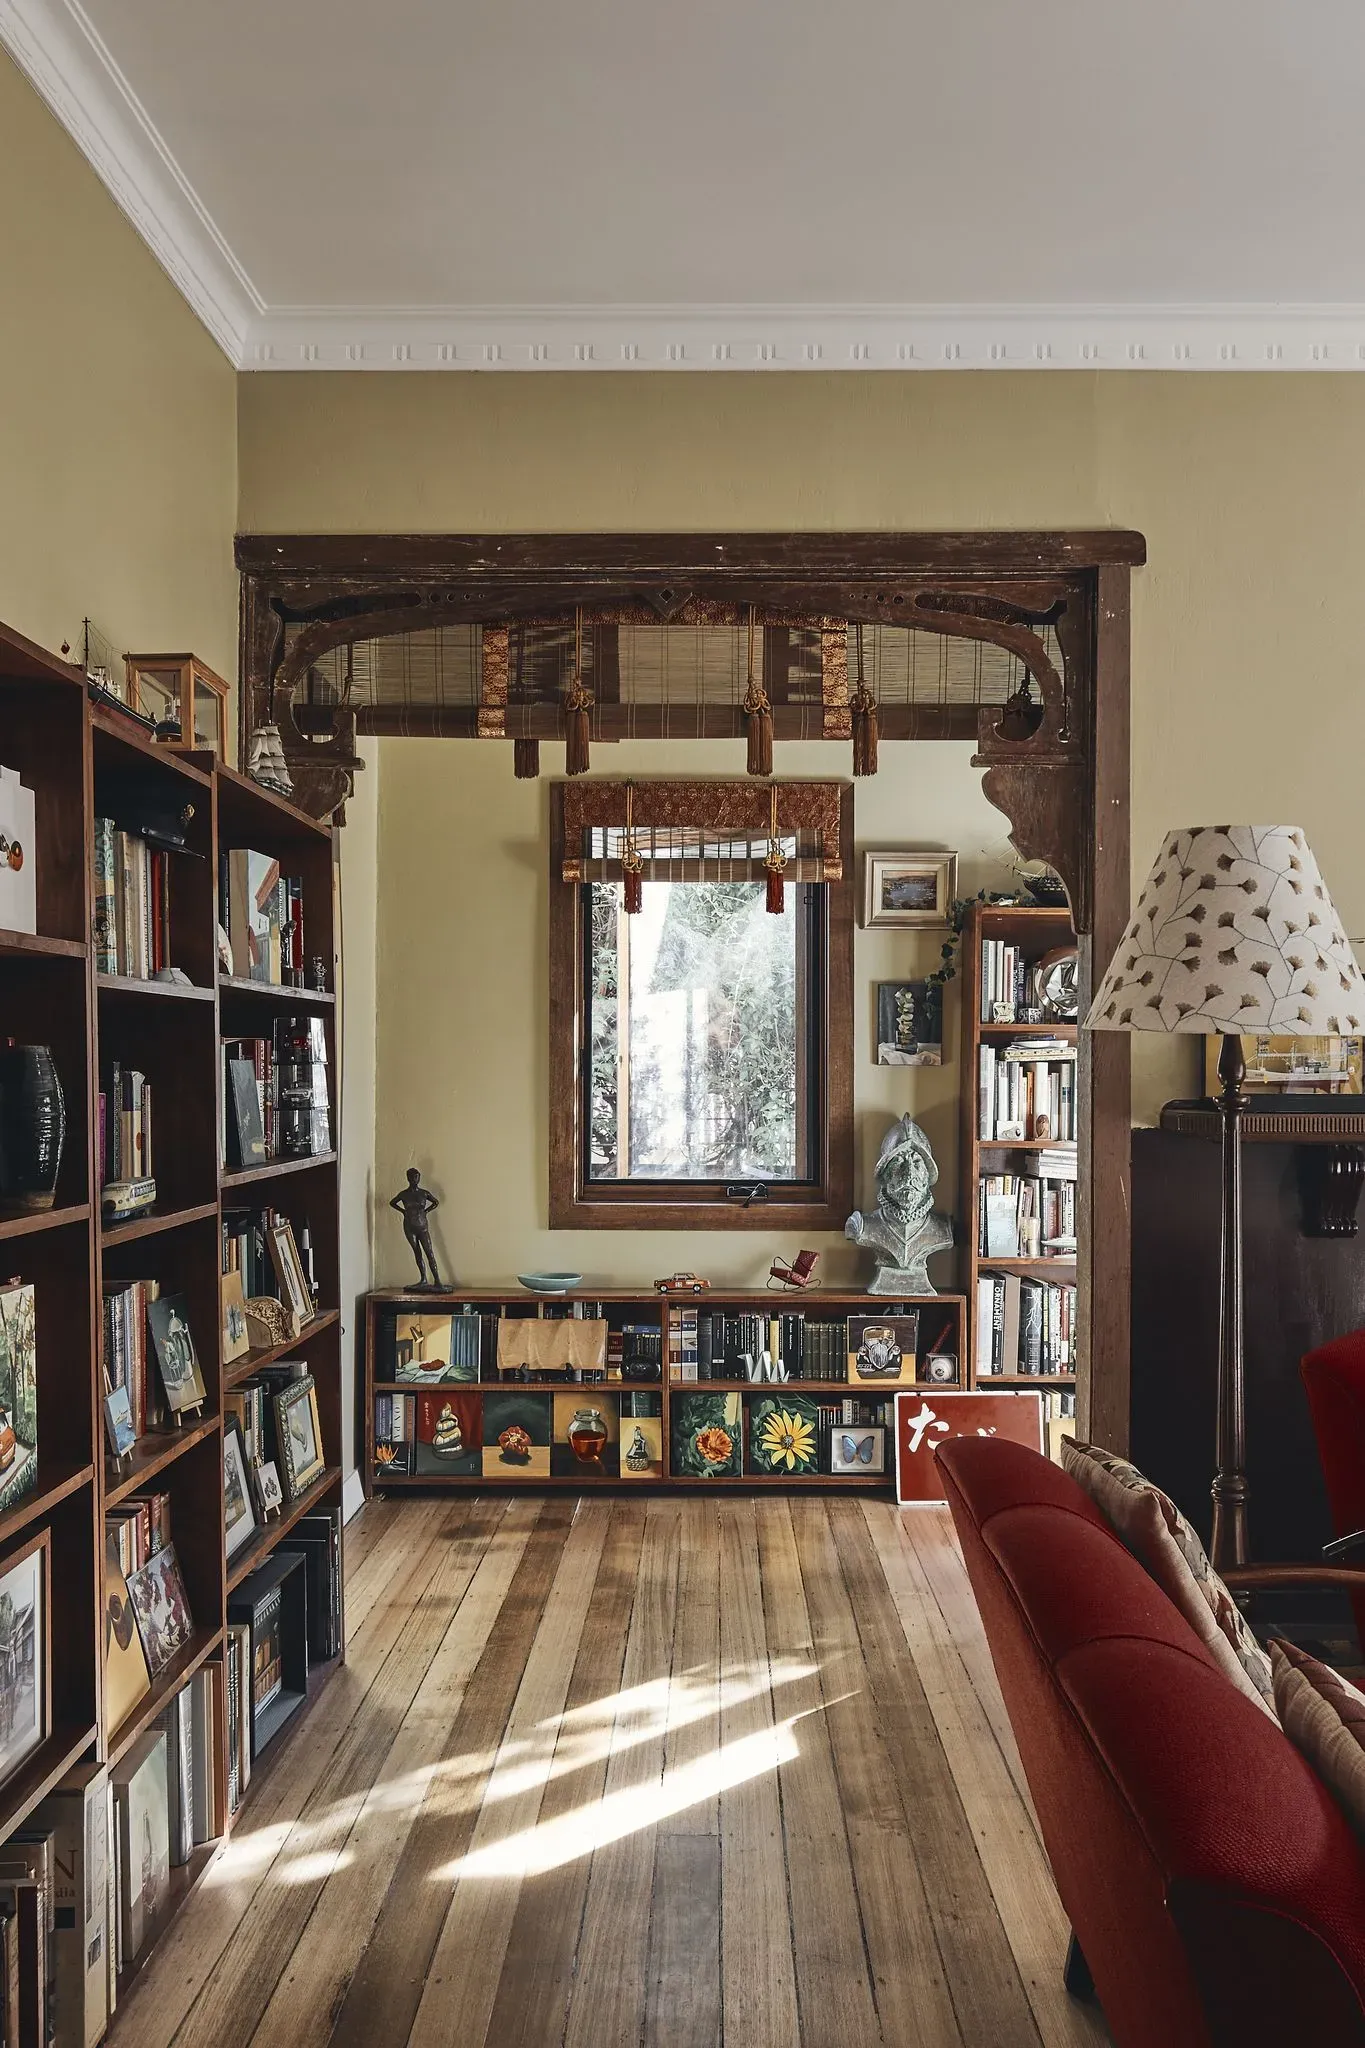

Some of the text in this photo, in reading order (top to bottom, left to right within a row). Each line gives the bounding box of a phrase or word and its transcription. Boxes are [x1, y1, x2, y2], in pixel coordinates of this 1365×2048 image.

[993, 1286, 1001, 1331] ORNAMENT
[185, 1719, 194, 1831] SCULPTURE
[95, 1785, 105, 1908] JAPAN
